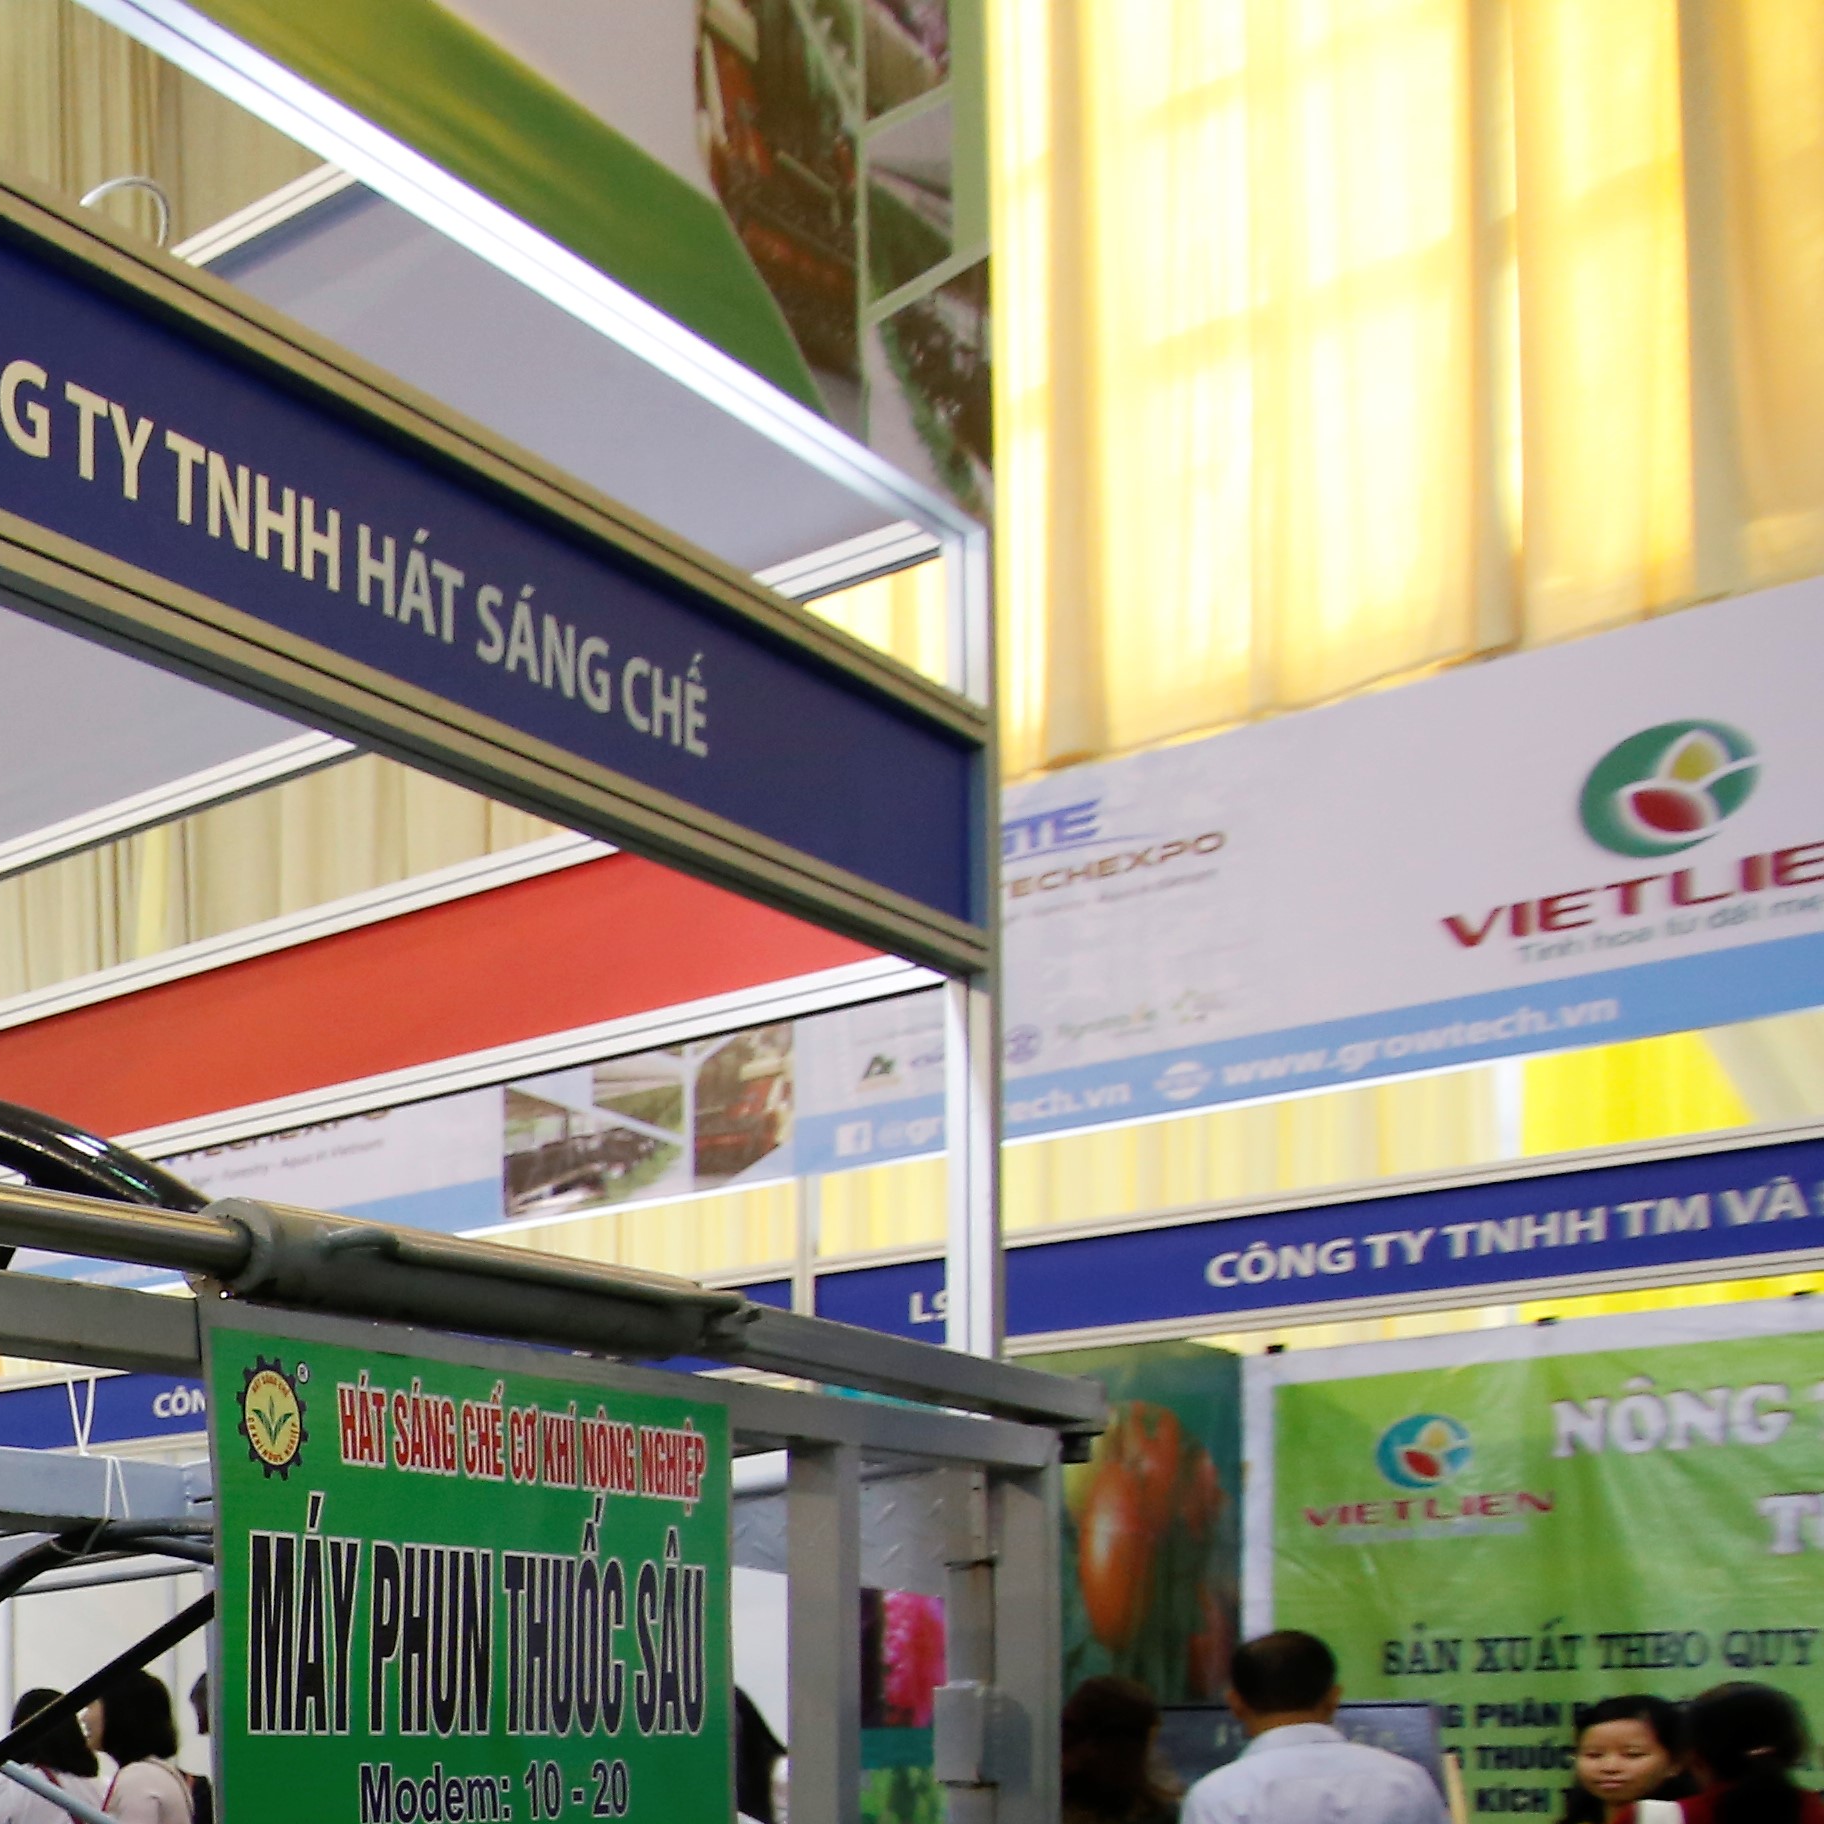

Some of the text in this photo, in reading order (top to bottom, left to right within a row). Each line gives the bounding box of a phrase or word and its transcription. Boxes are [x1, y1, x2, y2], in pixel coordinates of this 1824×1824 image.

[64, 383, 154, 502] TY
[166, 428, 342, 594] TNHH
[358, 524, 465, 644] HÁT
[476, 585, 611, 714] SÁNG
[620, 652, 709, 758] CHẾ
[1440, 840, 1824, 948] VIETLIE
[1222, 998, 1621, 1086] www.growtech.vn
[1204, 1240, 1356, 1288] CÔNG
[1362, 1226, 1436, 1270] TY
[1441, 1206, 1608, 1260] TNHH
[1614, 1192, 1712, 1239] TM
[153, 1385, 207, 1418] CÔN
[337, 1369, 705, 1516] HÁT SÁNG CHẾ CƠ KHÍ NÔNG NGHIỆP
[1551, 1374, 1795, 1458] NÔNG
[1302, 1489, 1556, 1528] VIETLIEN
[248, 1491, 706, 1738] MÁY PHUN THUỐC SÂU
[1381, 1615, 1819, 1677] SẢN XUẤT THEO QUY
[1475, 1701, 1564, 1729] PHÂN
[523, 1759, 562, 1820] 10
[571, 1784, 584, 1805] -
[591, 1758, 630, 1818] 20
